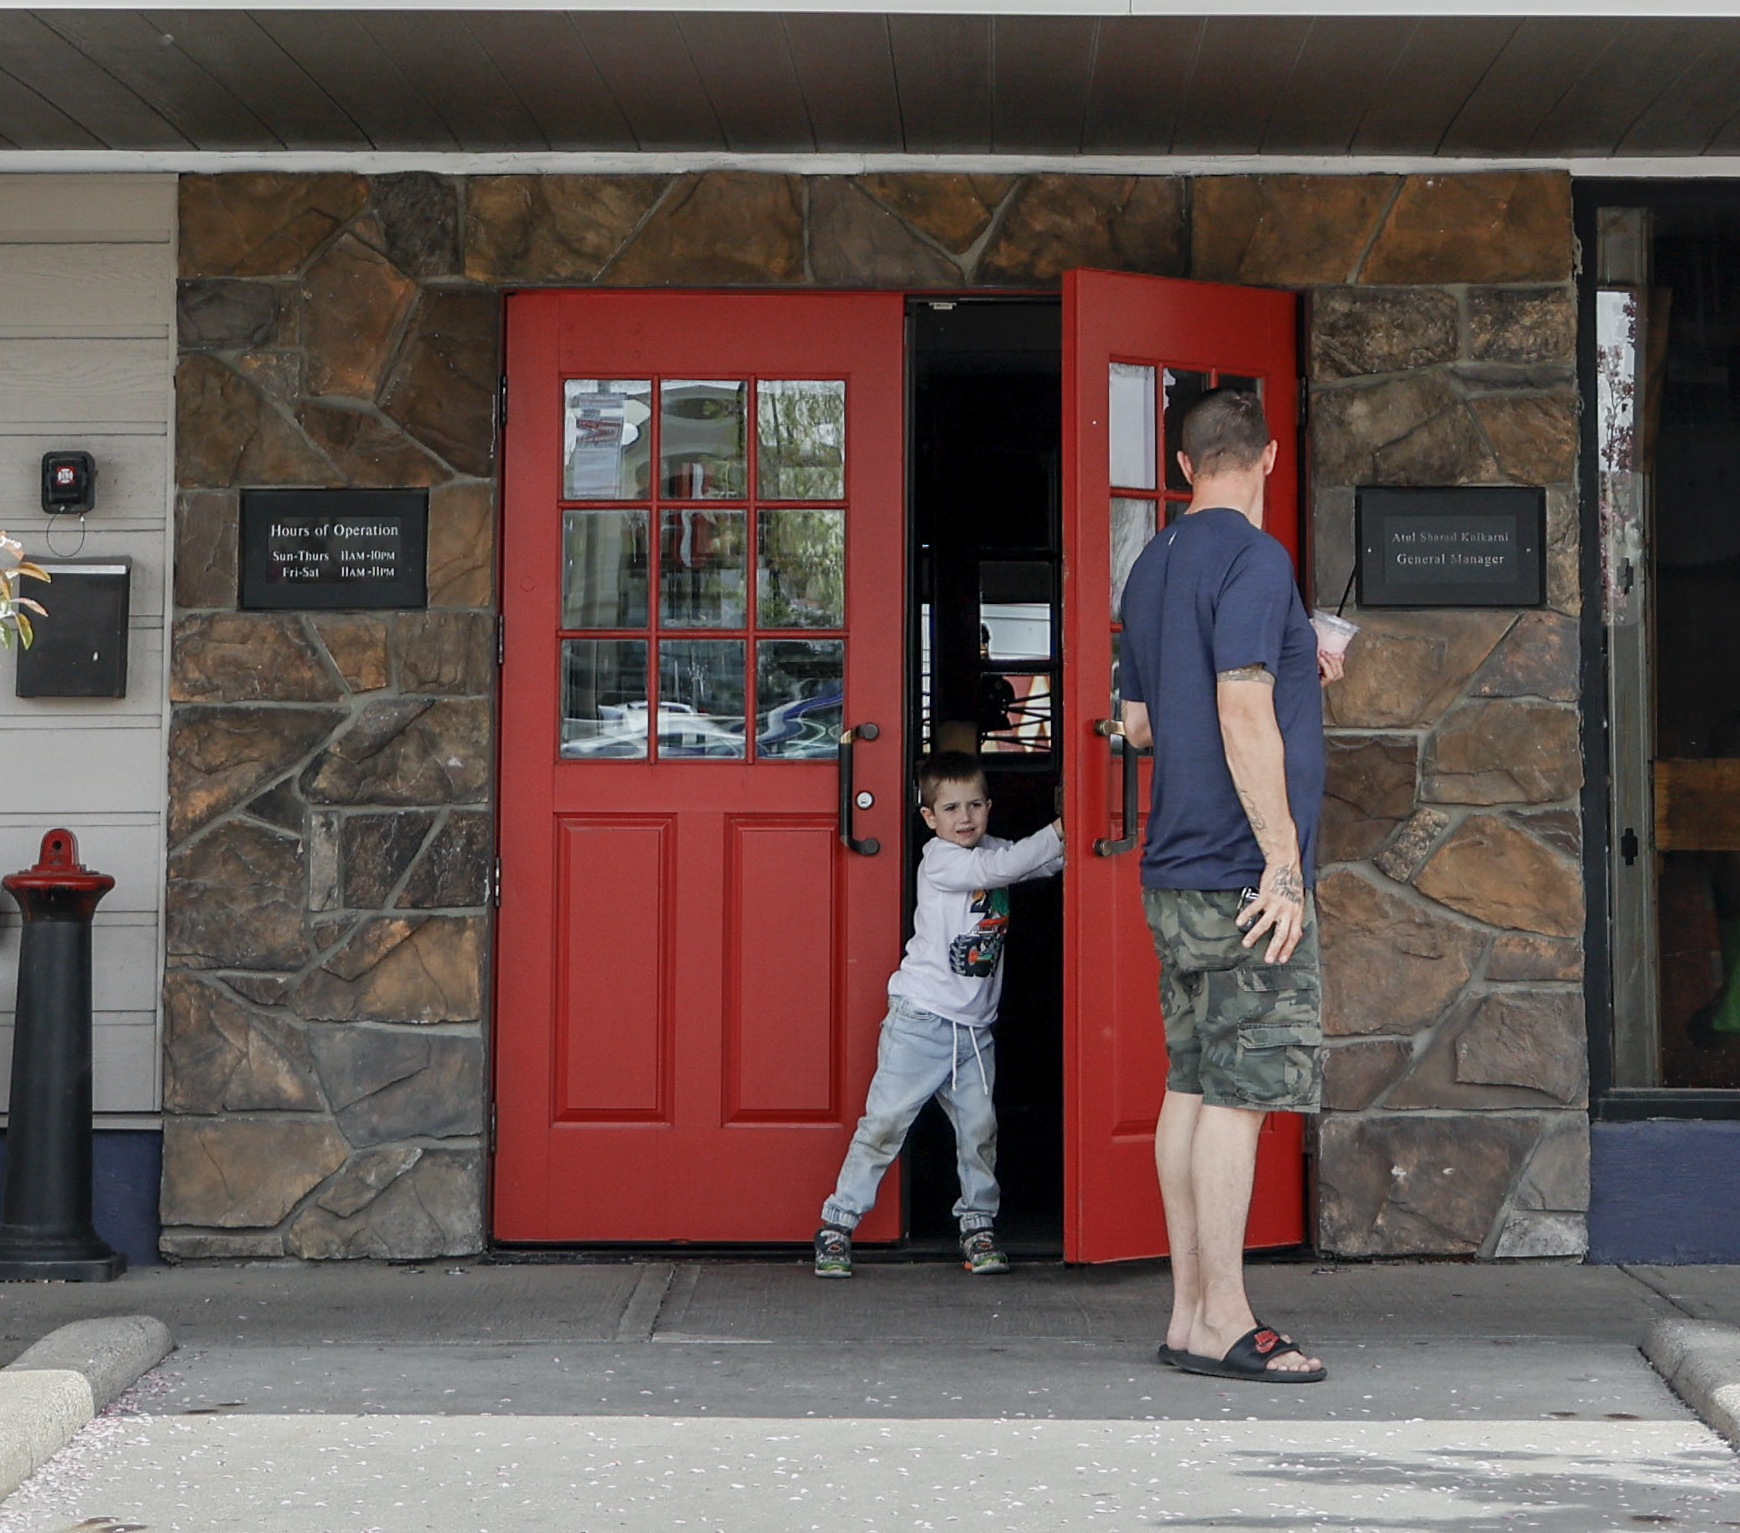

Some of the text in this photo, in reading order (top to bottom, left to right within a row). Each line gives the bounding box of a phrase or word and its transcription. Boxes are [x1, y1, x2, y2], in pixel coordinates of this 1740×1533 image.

[271, 524, 399, 538] Hours of Operation
[272, 551, 329, 562] Sun-Thurs
[1396, 553, 1505, 567] General Manager
[282, 566, 319, 578] Fri-Sat
